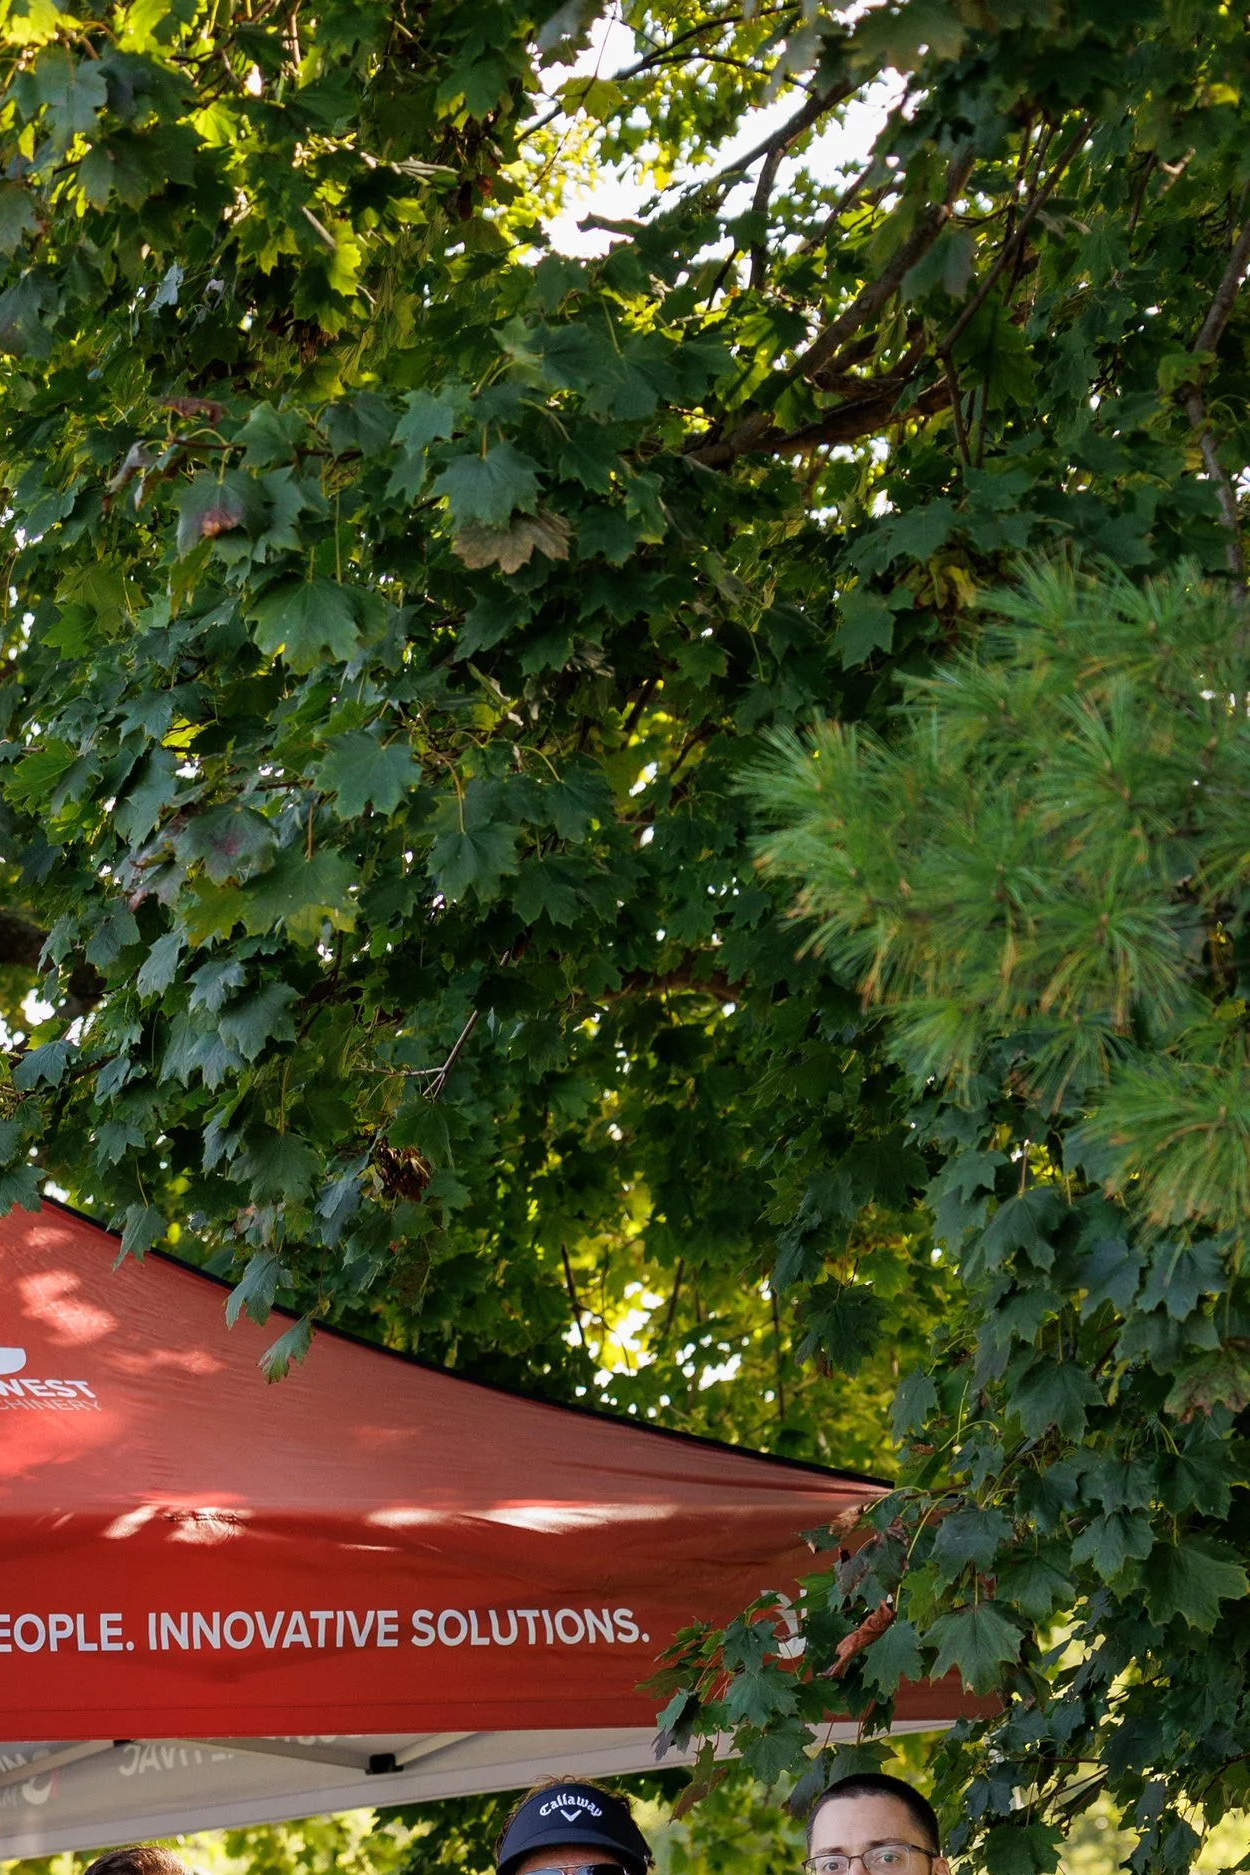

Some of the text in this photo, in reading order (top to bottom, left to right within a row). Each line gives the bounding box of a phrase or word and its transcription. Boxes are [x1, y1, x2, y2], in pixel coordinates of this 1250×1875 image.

[148, 1608, 399, 1651] INNOVATIVE
[410, 1606, 651, 1648] SOLUTIONS.
[539, 1793, 603, 1818] Callaway
